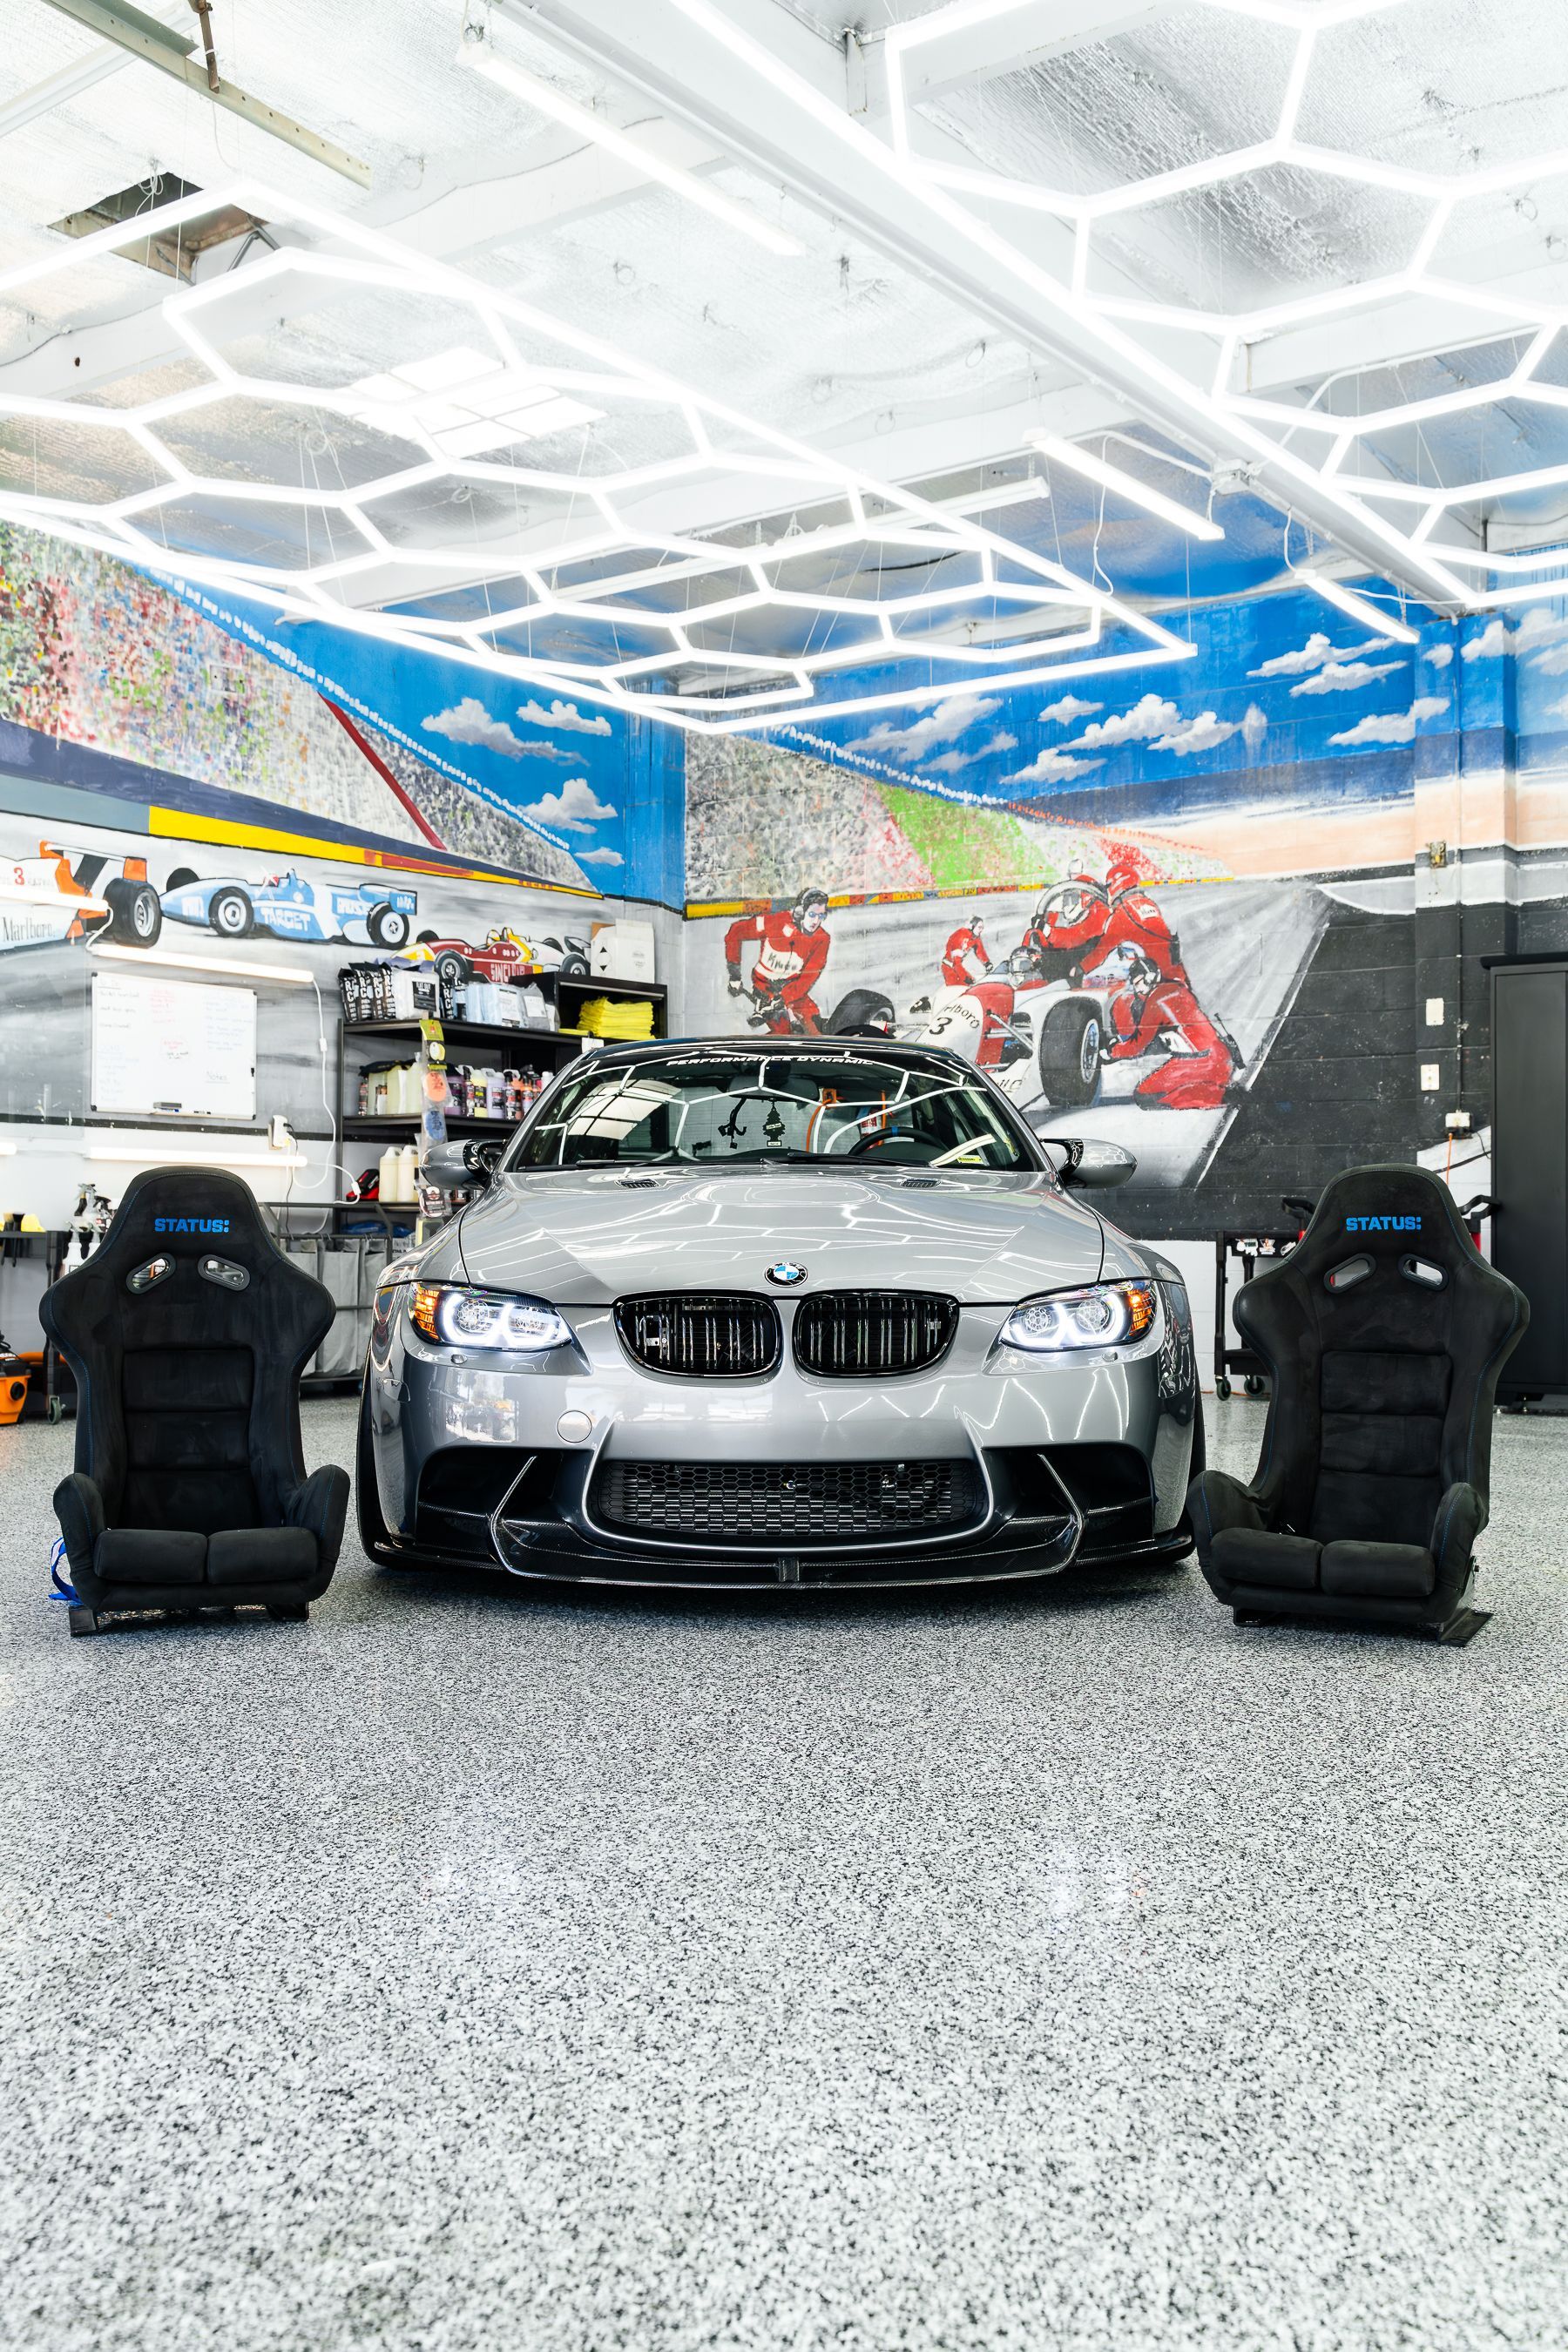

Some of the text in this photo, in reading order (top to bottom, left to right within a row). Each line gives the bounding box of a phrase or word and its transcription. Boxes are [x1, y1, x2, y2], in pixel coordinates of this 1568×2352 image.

[13, 867, 25, 886] 3
[260, 907, 311, 931] TARGET
[929, 1017, 953, 1035] 3
[666, 1056, 793, 1066] PERFORMANCE
